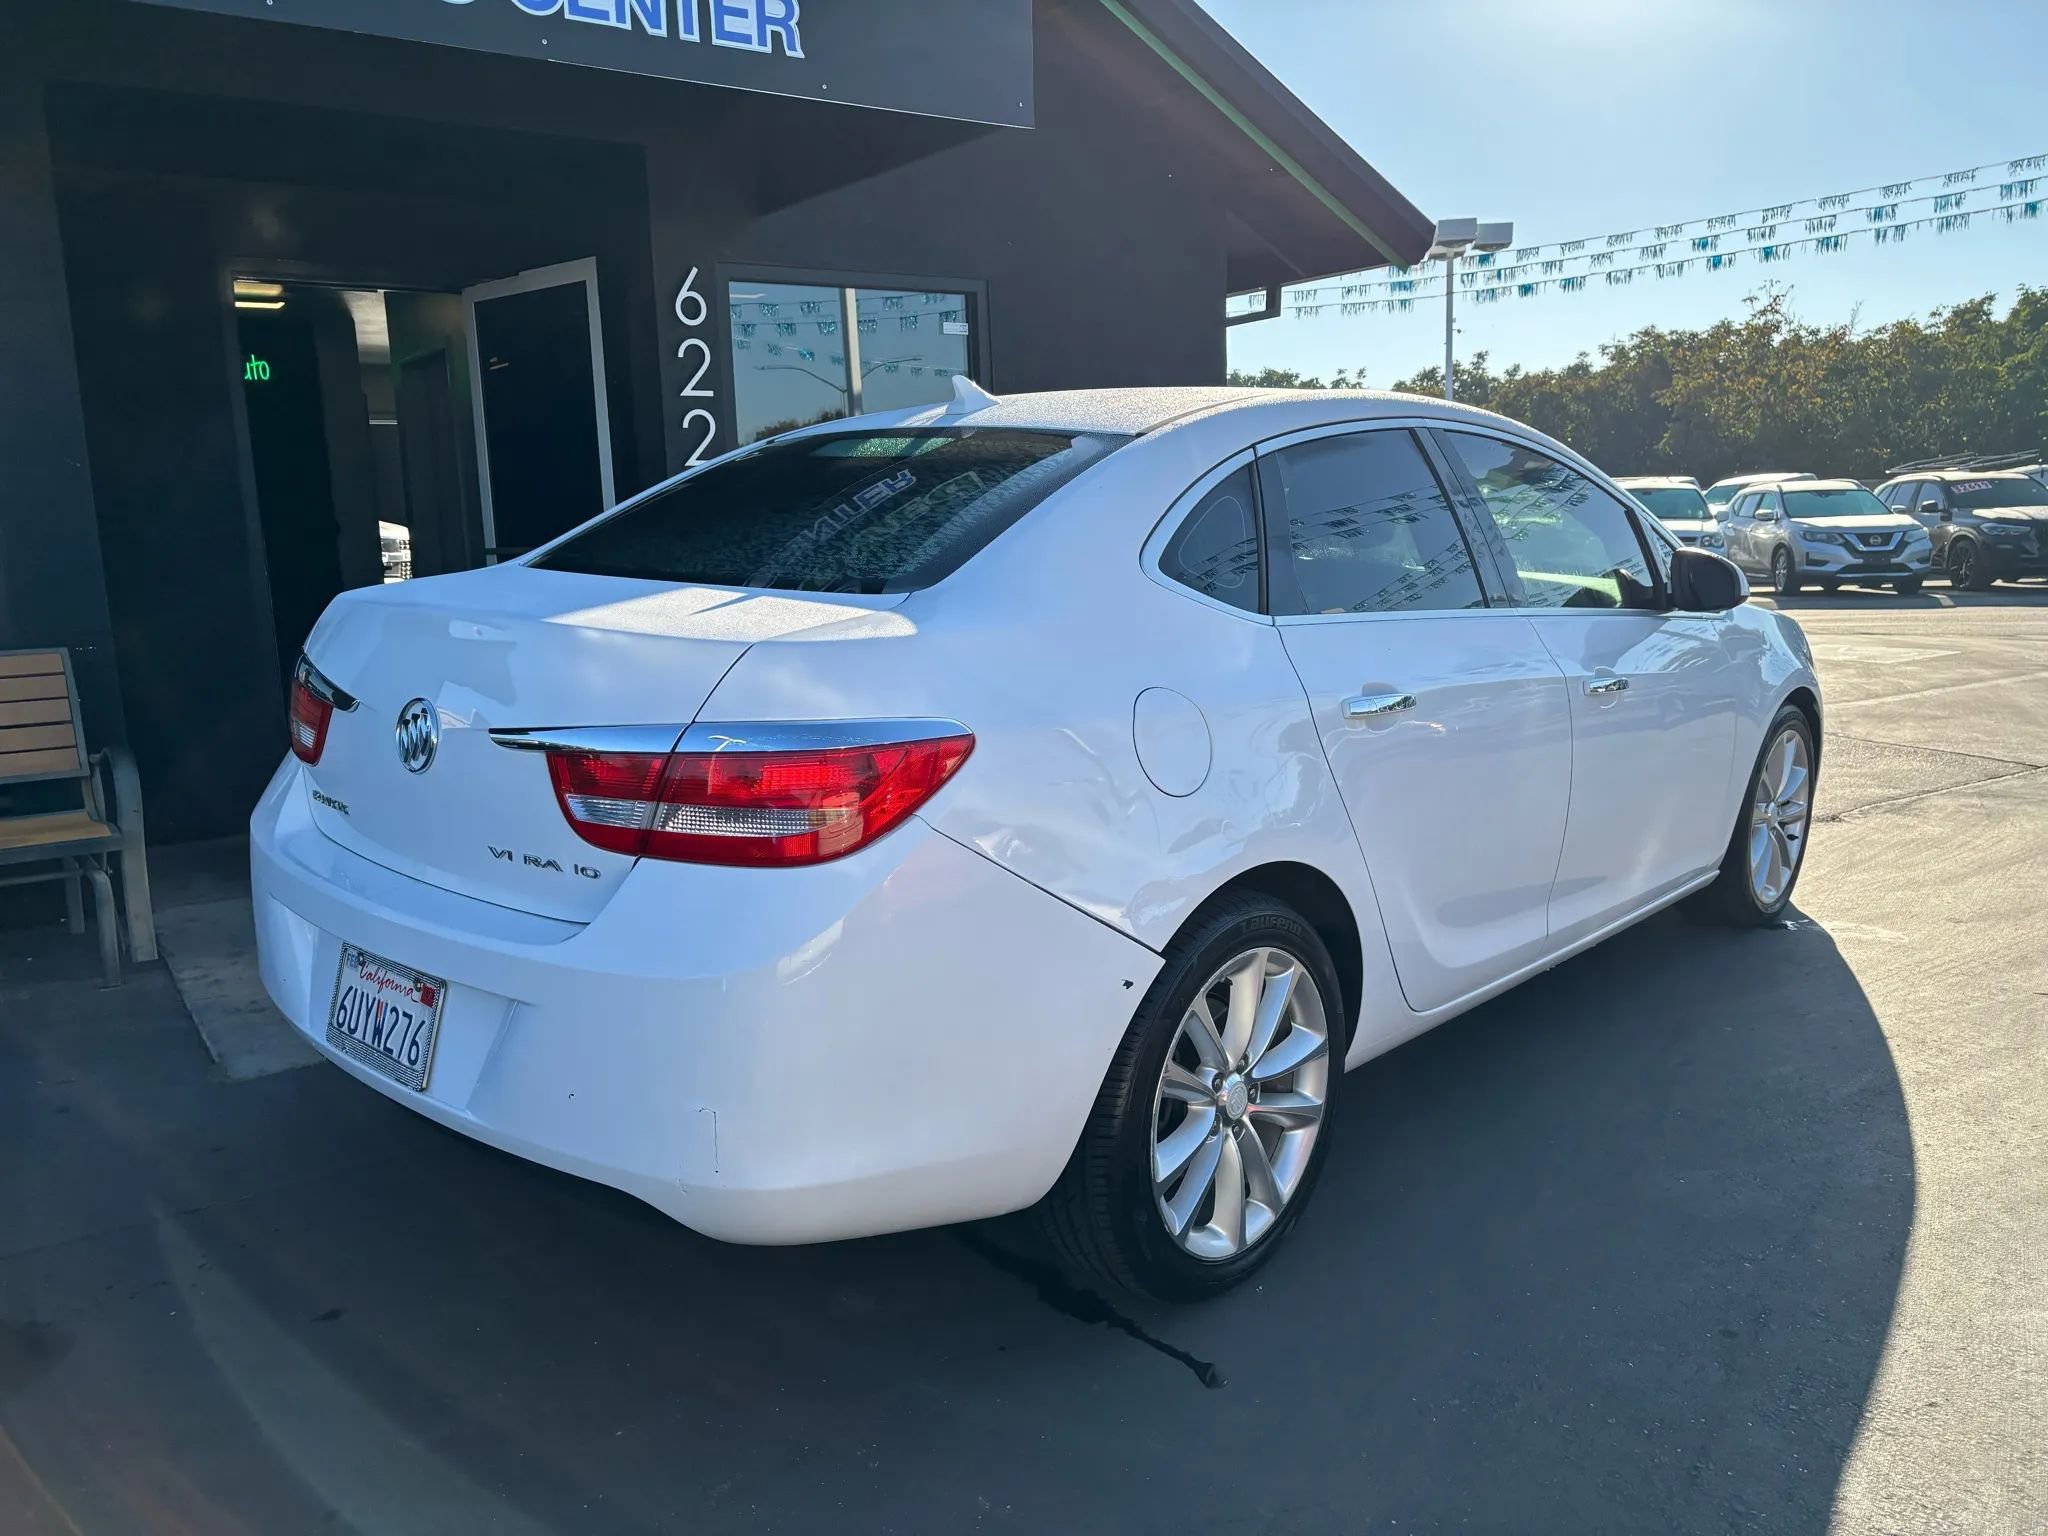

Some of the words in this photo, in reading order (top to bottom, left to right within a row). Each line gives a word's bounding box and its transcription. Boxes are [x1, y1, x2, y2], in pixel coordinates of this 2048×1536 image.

[510, 0, 806, 59] NTER
[675, 266, 716, 467] 622
[358, 962, 420, 1003] California
[335, 985, 426, 1066] 6UYW276
